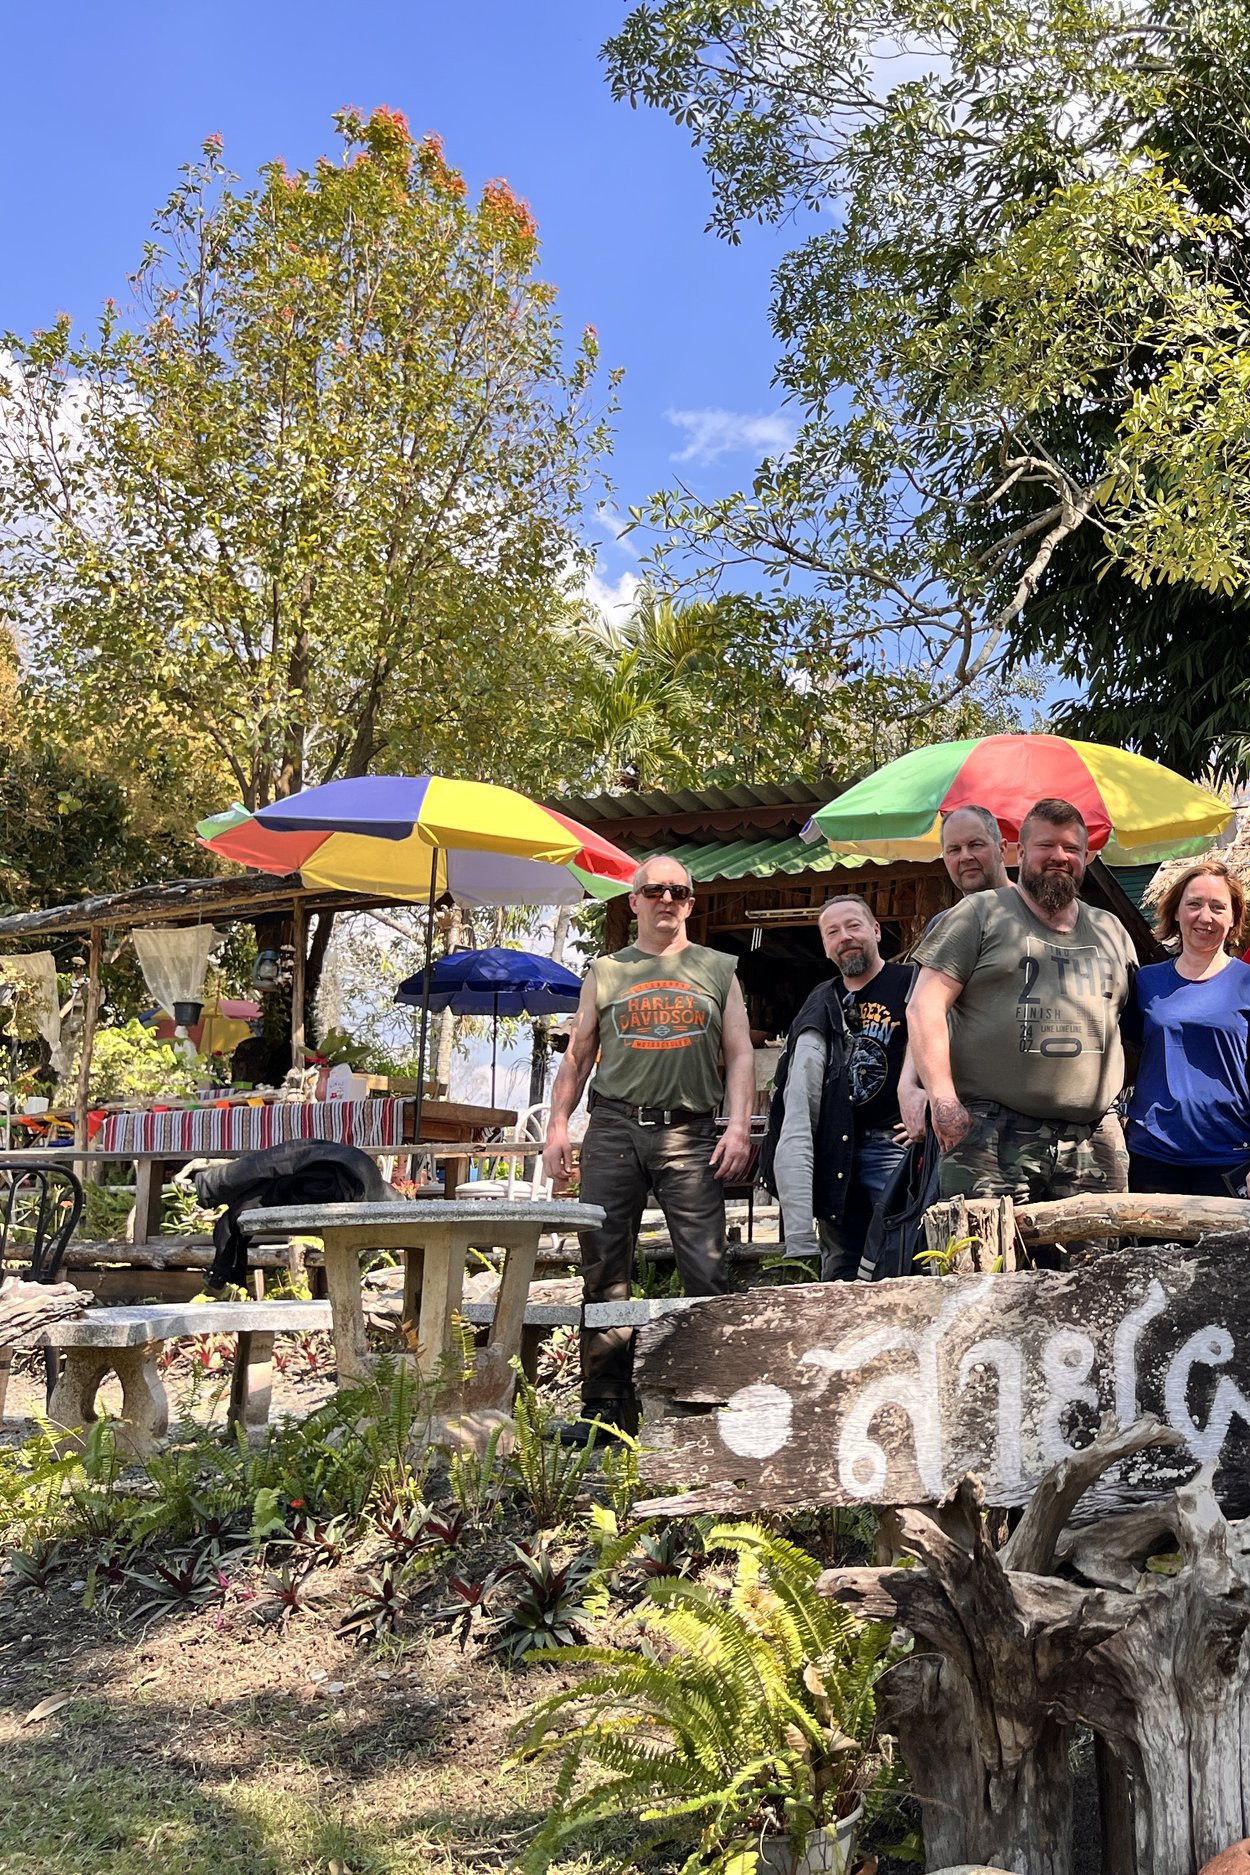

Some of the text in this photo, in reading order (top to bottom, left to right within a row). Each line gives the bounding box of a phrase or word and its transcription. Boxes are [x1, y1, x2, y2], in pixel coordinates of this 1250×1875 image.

[1018, 956, 1113, 1004] 2 THE
[628, 996, 694, 1012] HARLEY
[1016, 1007, 1061, 1019] FINISH
[619, 1010, 705, 1034] DAVIDSON
[1019, 1025, 1033, 1038] 24
